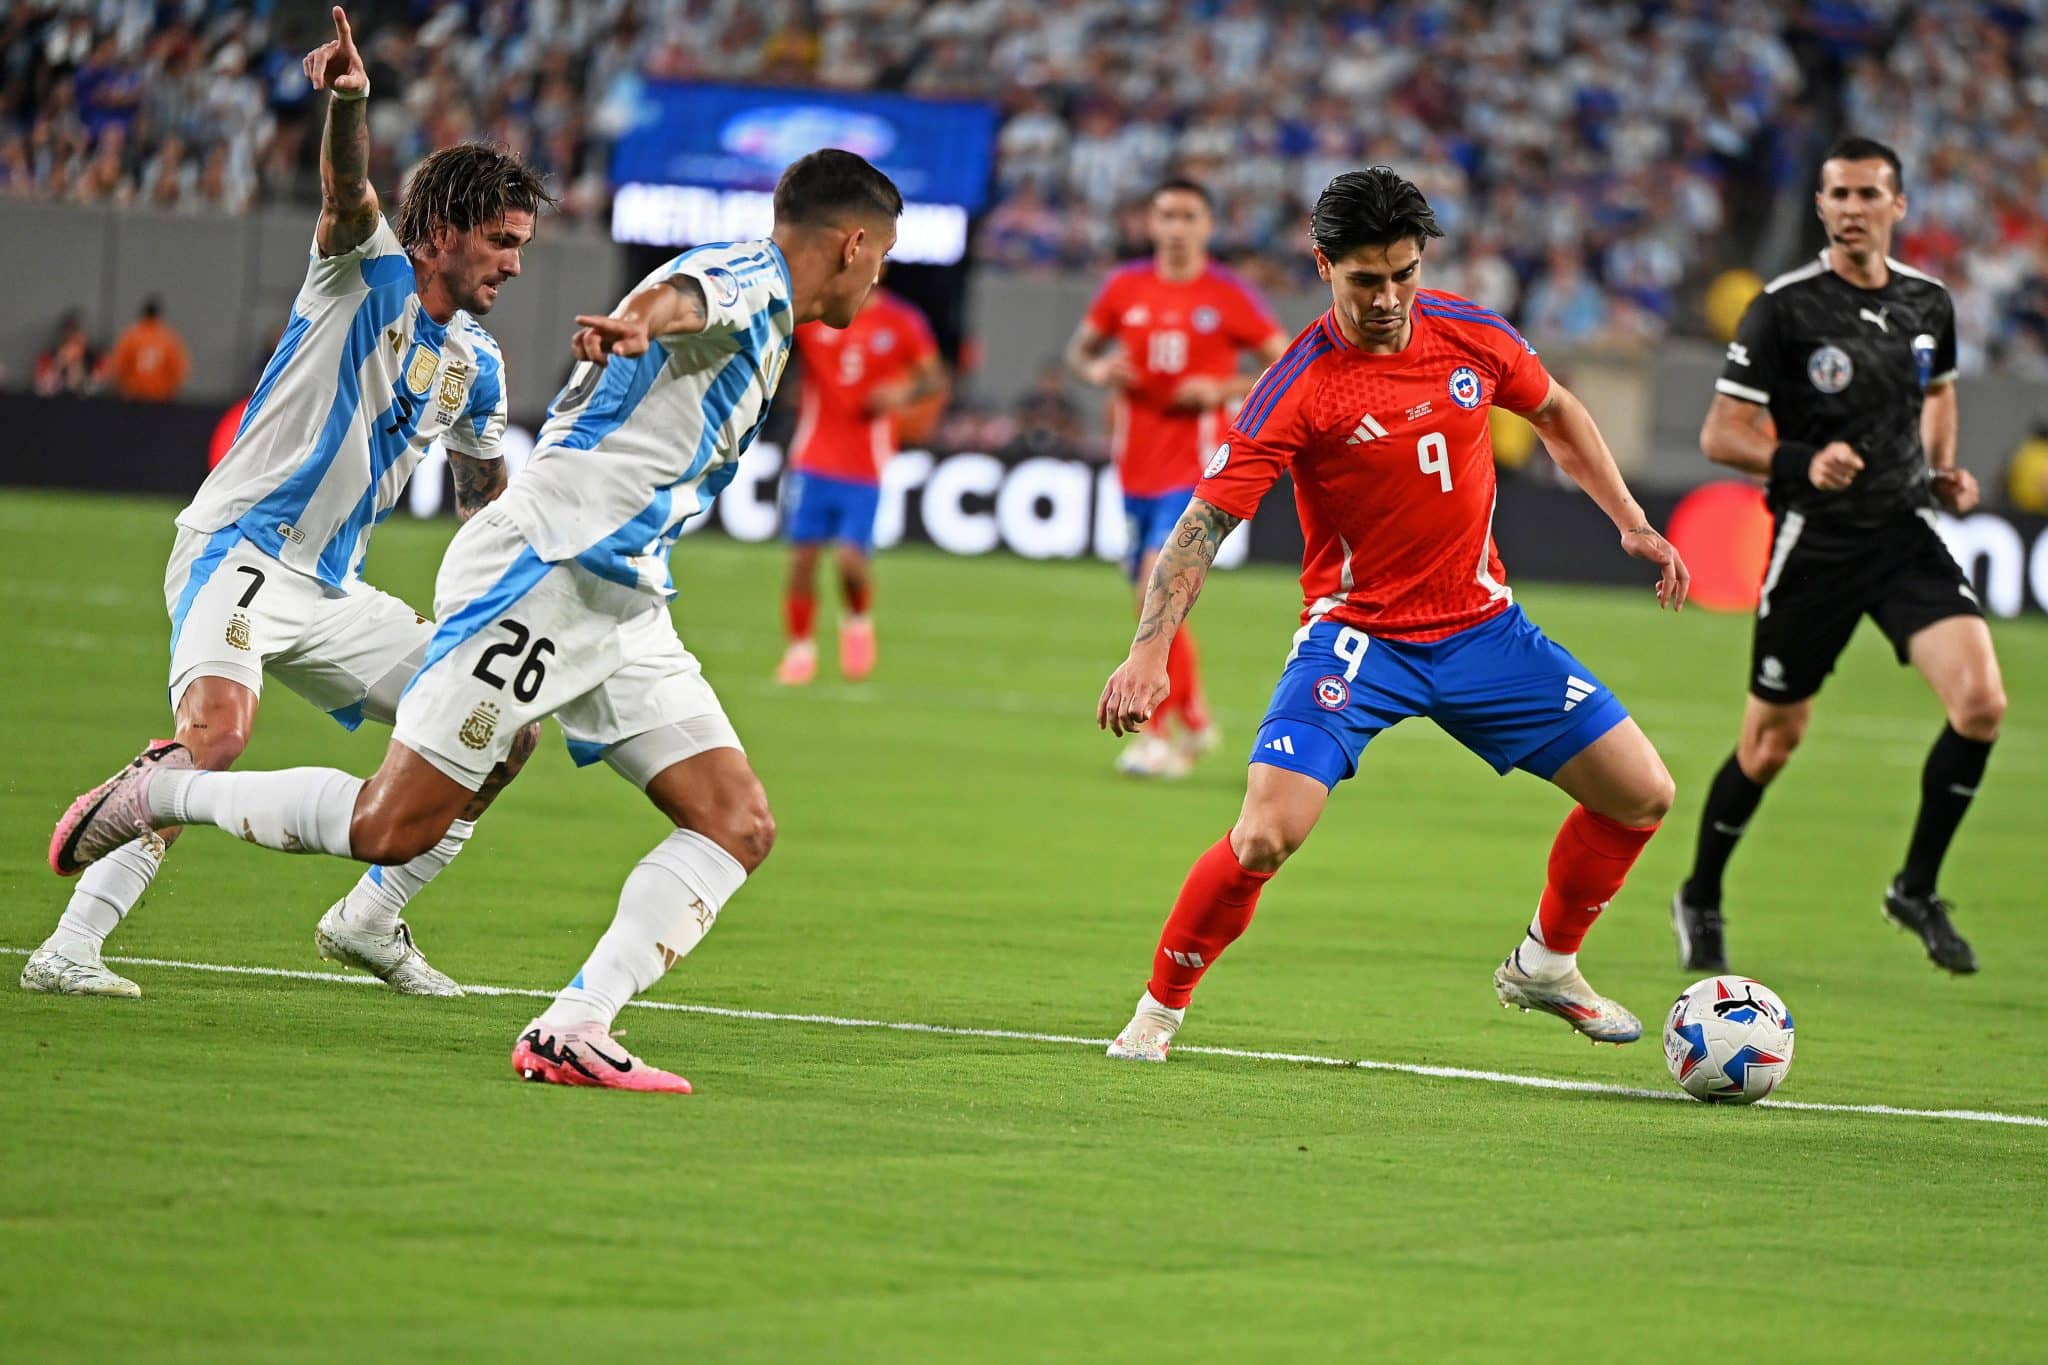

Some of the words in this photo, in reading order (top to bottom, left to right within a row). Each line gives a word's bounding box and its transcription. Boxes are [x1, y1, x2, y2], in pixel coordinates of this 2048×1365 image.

[1417, 432, 1453, 493] 9
[237, 566, 265, 608] 7
[472, 619, 556, 703] 26
[1334, 626, 1370, 683] 9
